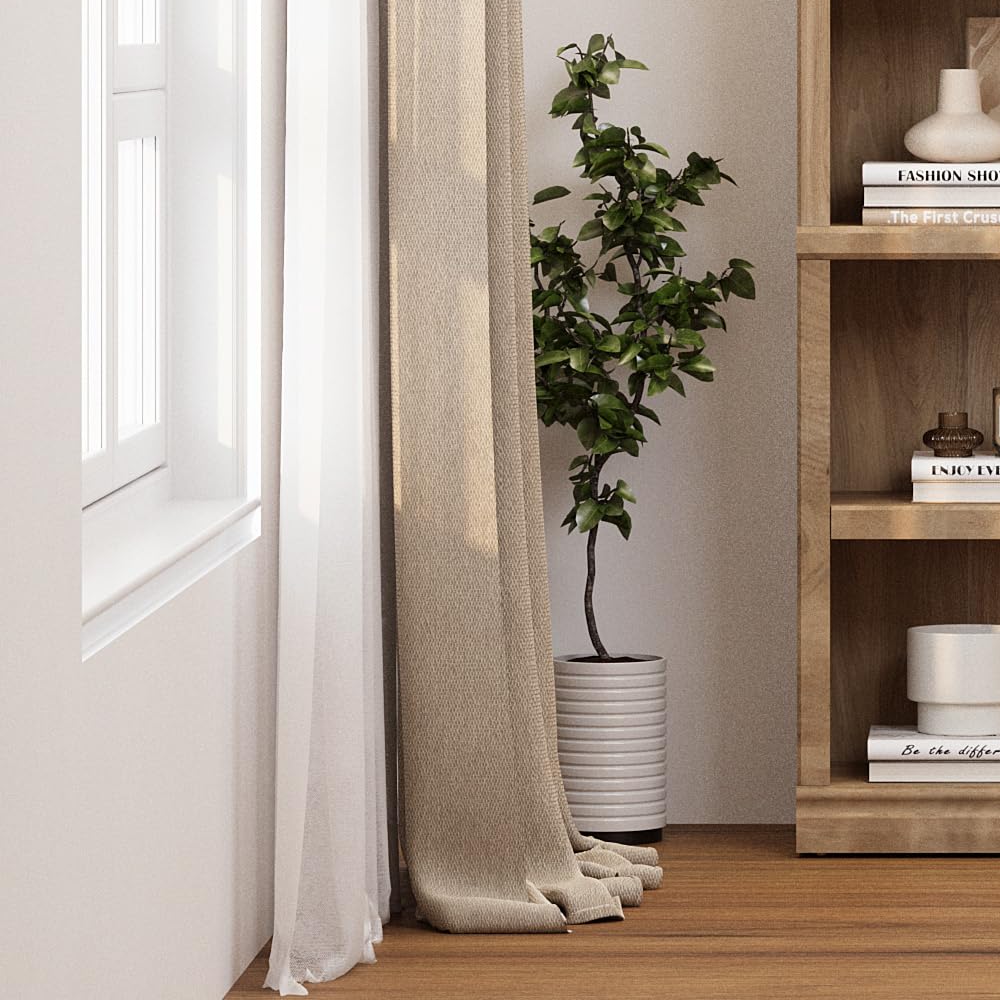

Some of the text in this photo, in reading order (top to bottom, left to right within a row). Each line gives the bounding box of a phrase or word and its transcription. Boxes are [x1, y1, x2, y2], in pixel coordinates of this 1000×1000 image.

[898, 170, 962, 182] FASHION
[922, 211, 958, 224] First
[931, 465, 973, 476] ENJOY
[901, 744, 920, 756] Be
[928, 744, 951, 756] the
